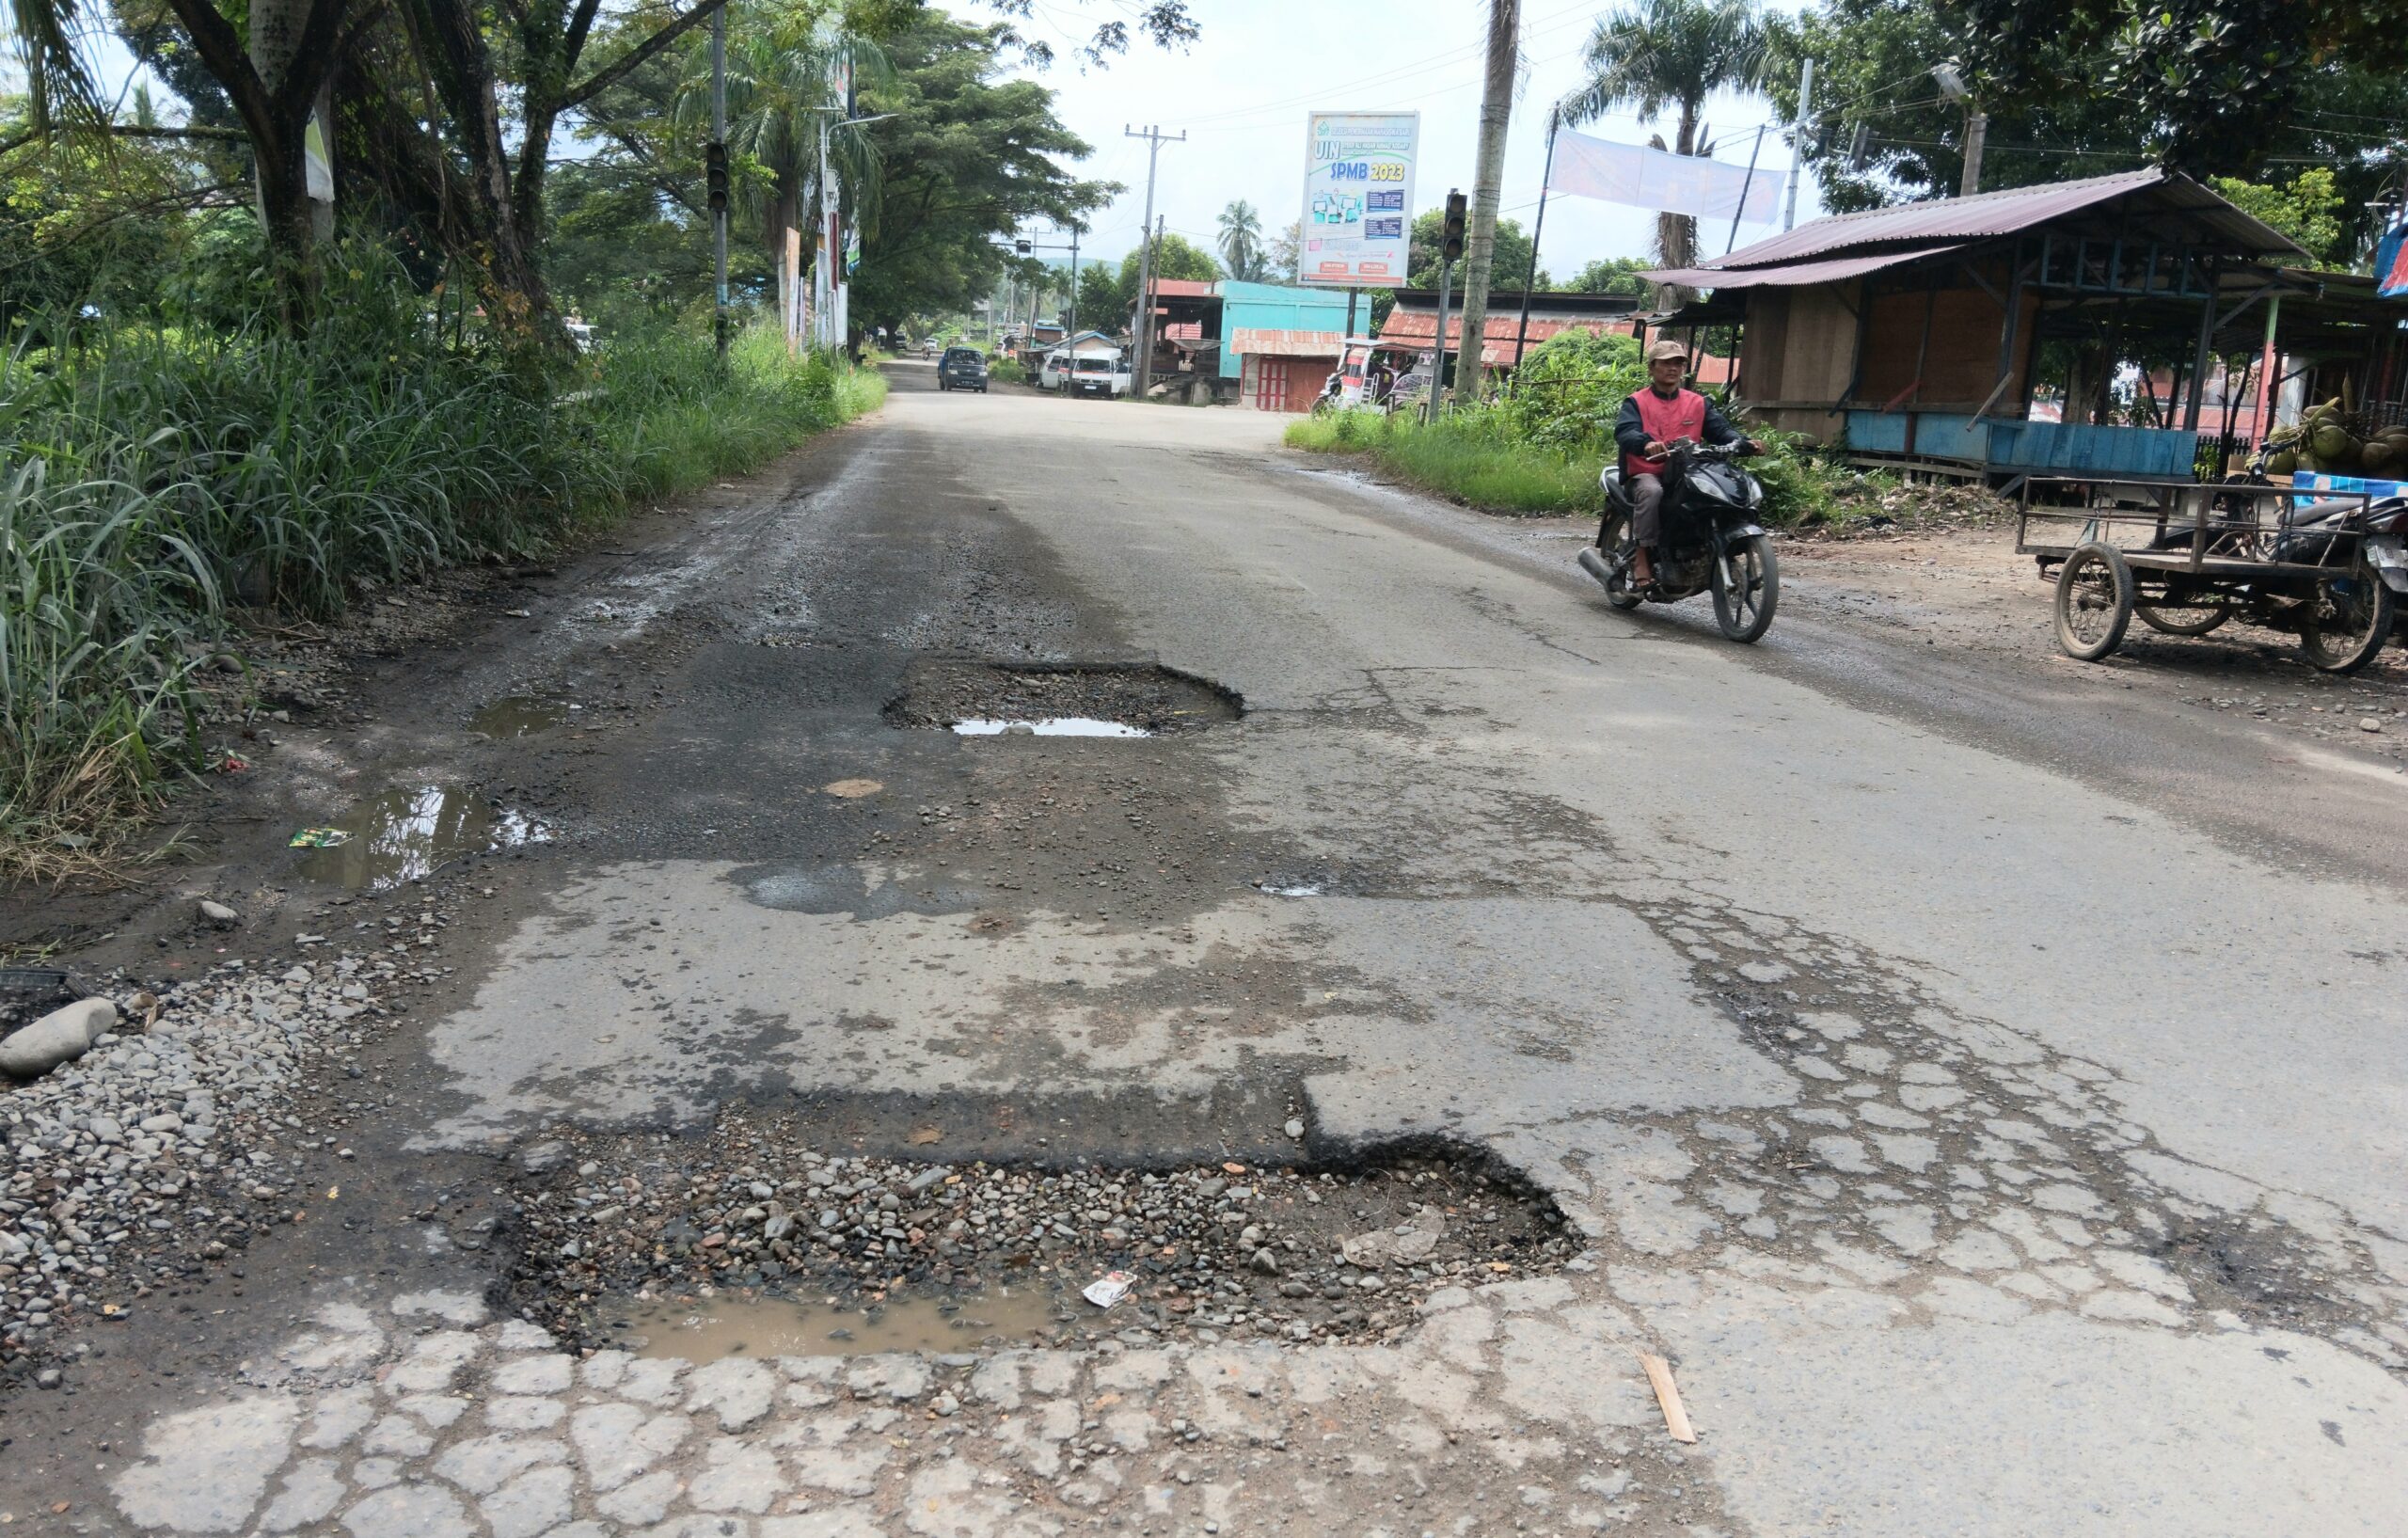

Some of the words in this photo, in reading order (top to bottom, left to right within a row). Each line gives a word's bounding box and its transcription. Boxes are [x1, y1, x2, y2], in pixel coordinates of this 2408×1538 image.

[1314, 141, 1340, 159] UIN
[1330, 162, 1368, 181] SPMB
[1370, 163, 1404, 182] 2023
